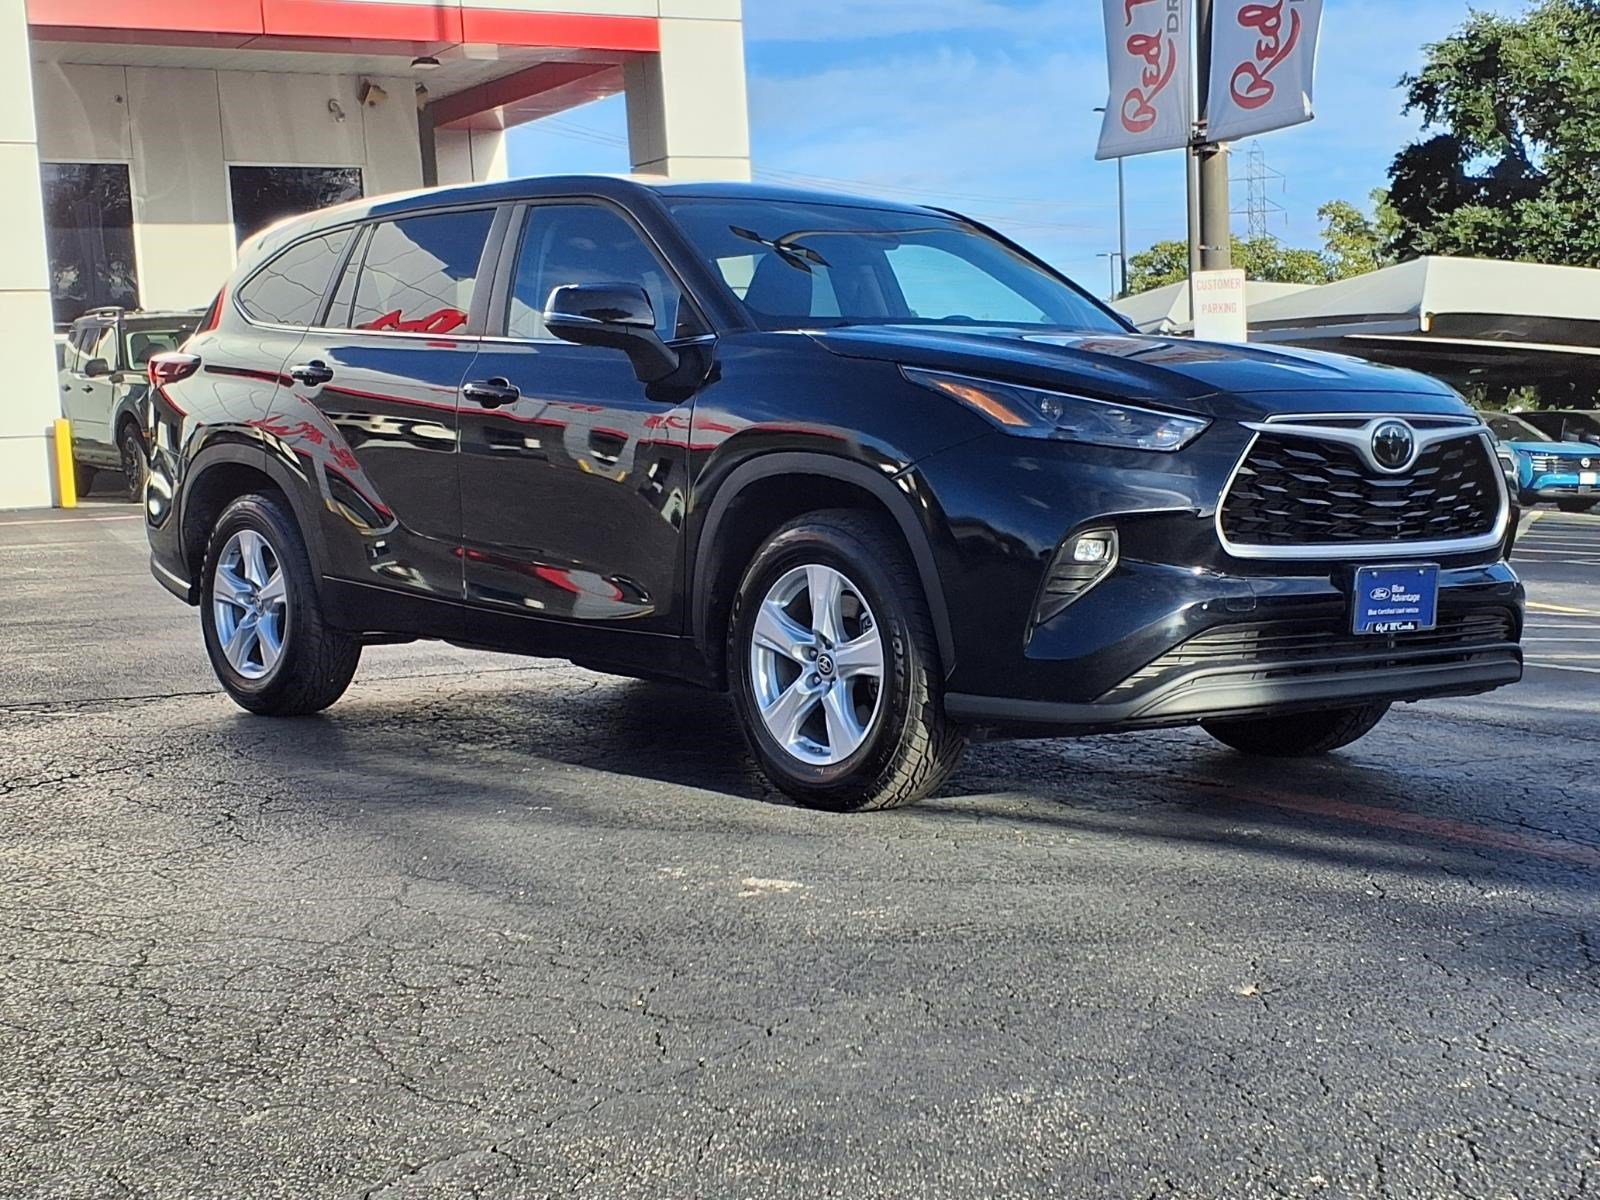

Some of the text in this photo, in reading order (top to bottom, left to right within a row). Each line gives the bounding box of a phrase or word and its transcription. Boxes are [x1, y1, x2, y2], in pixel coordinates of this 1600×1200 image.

[1230, 0, 1301, 110] Red
[1121, 28, 1176, 134] Red
[1196, 278, 1241, 291] CUSTOMER
[1201, 302, 1237, 314] PARKING
[1392, 584, 1404, 592] Blue
[1392, 594, 1420, 602] Advantage
